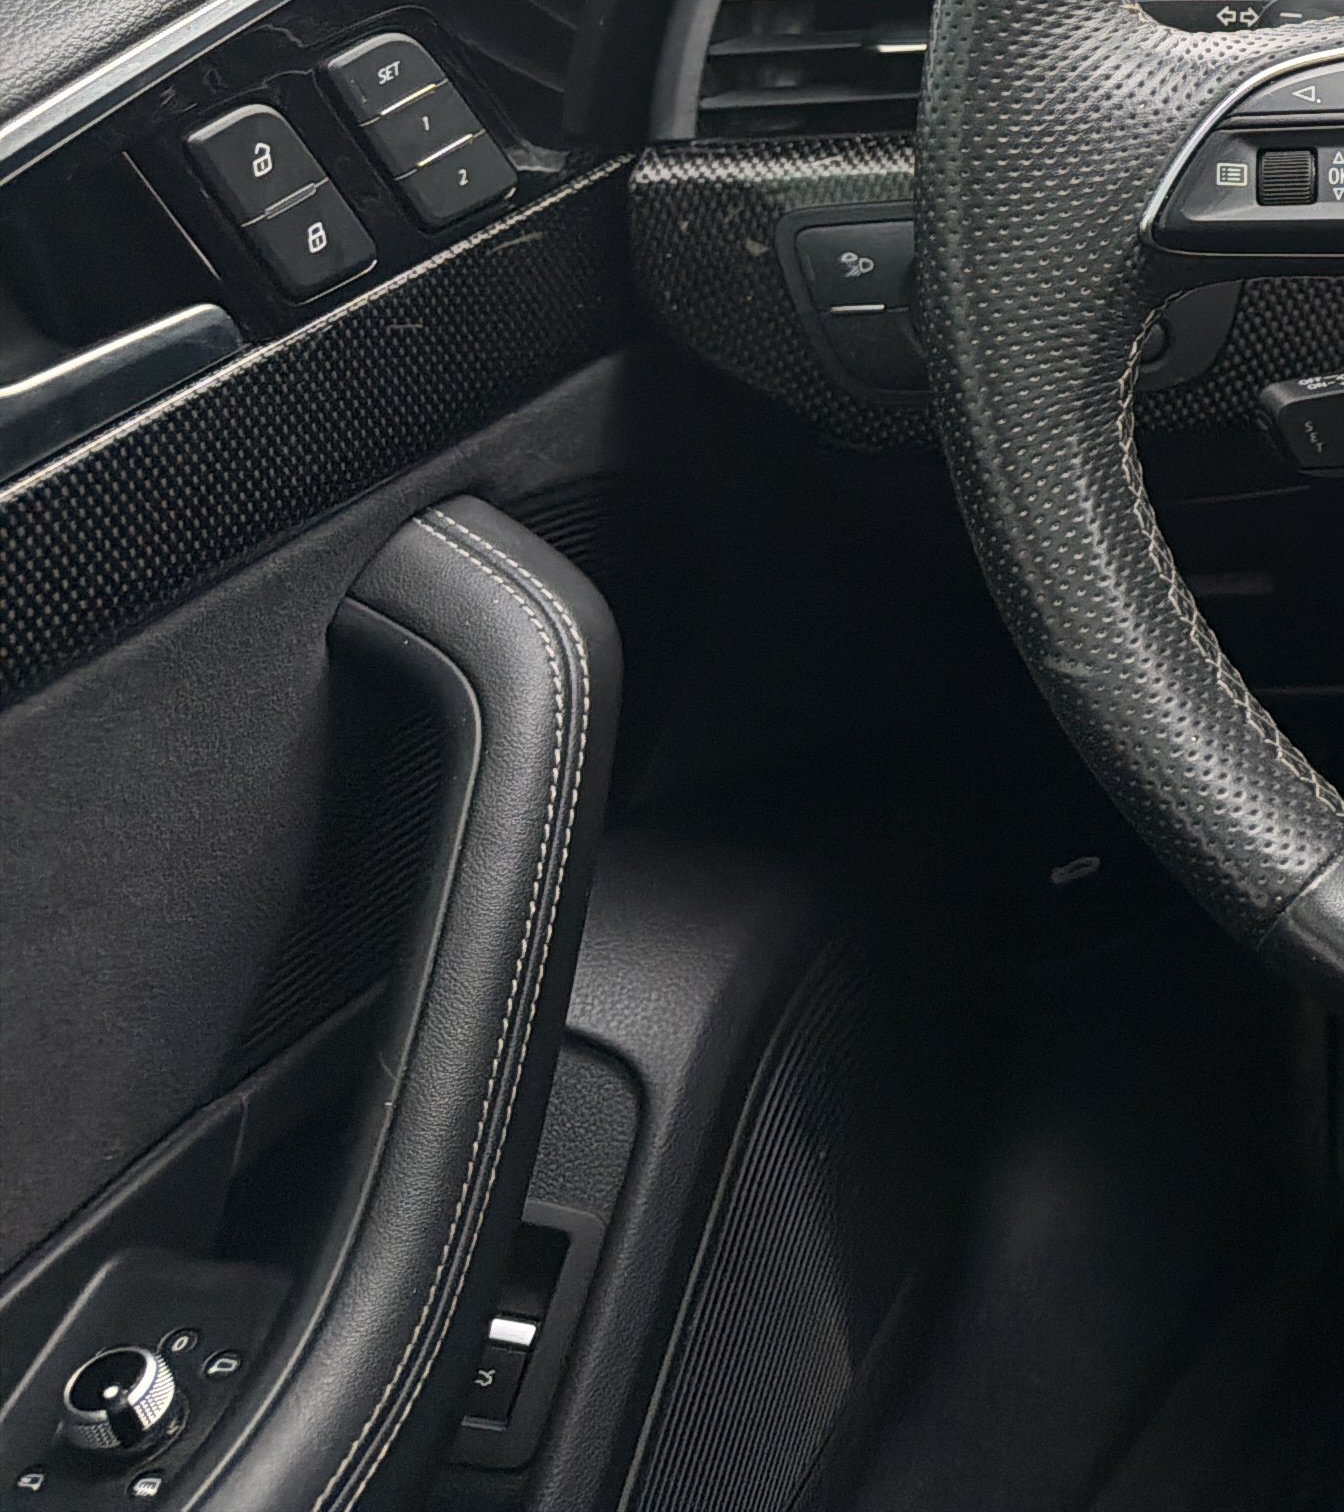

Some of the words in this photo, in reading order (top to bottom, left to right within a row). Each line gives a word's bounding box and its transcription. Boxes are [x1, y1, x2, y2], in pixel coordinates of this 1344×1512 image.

[377, 60, 401, 85] SET
[421, 115, 430, 131] 1
[458, 168, 469, 186] 2
[1298, 373, 1323, 387] OFF
